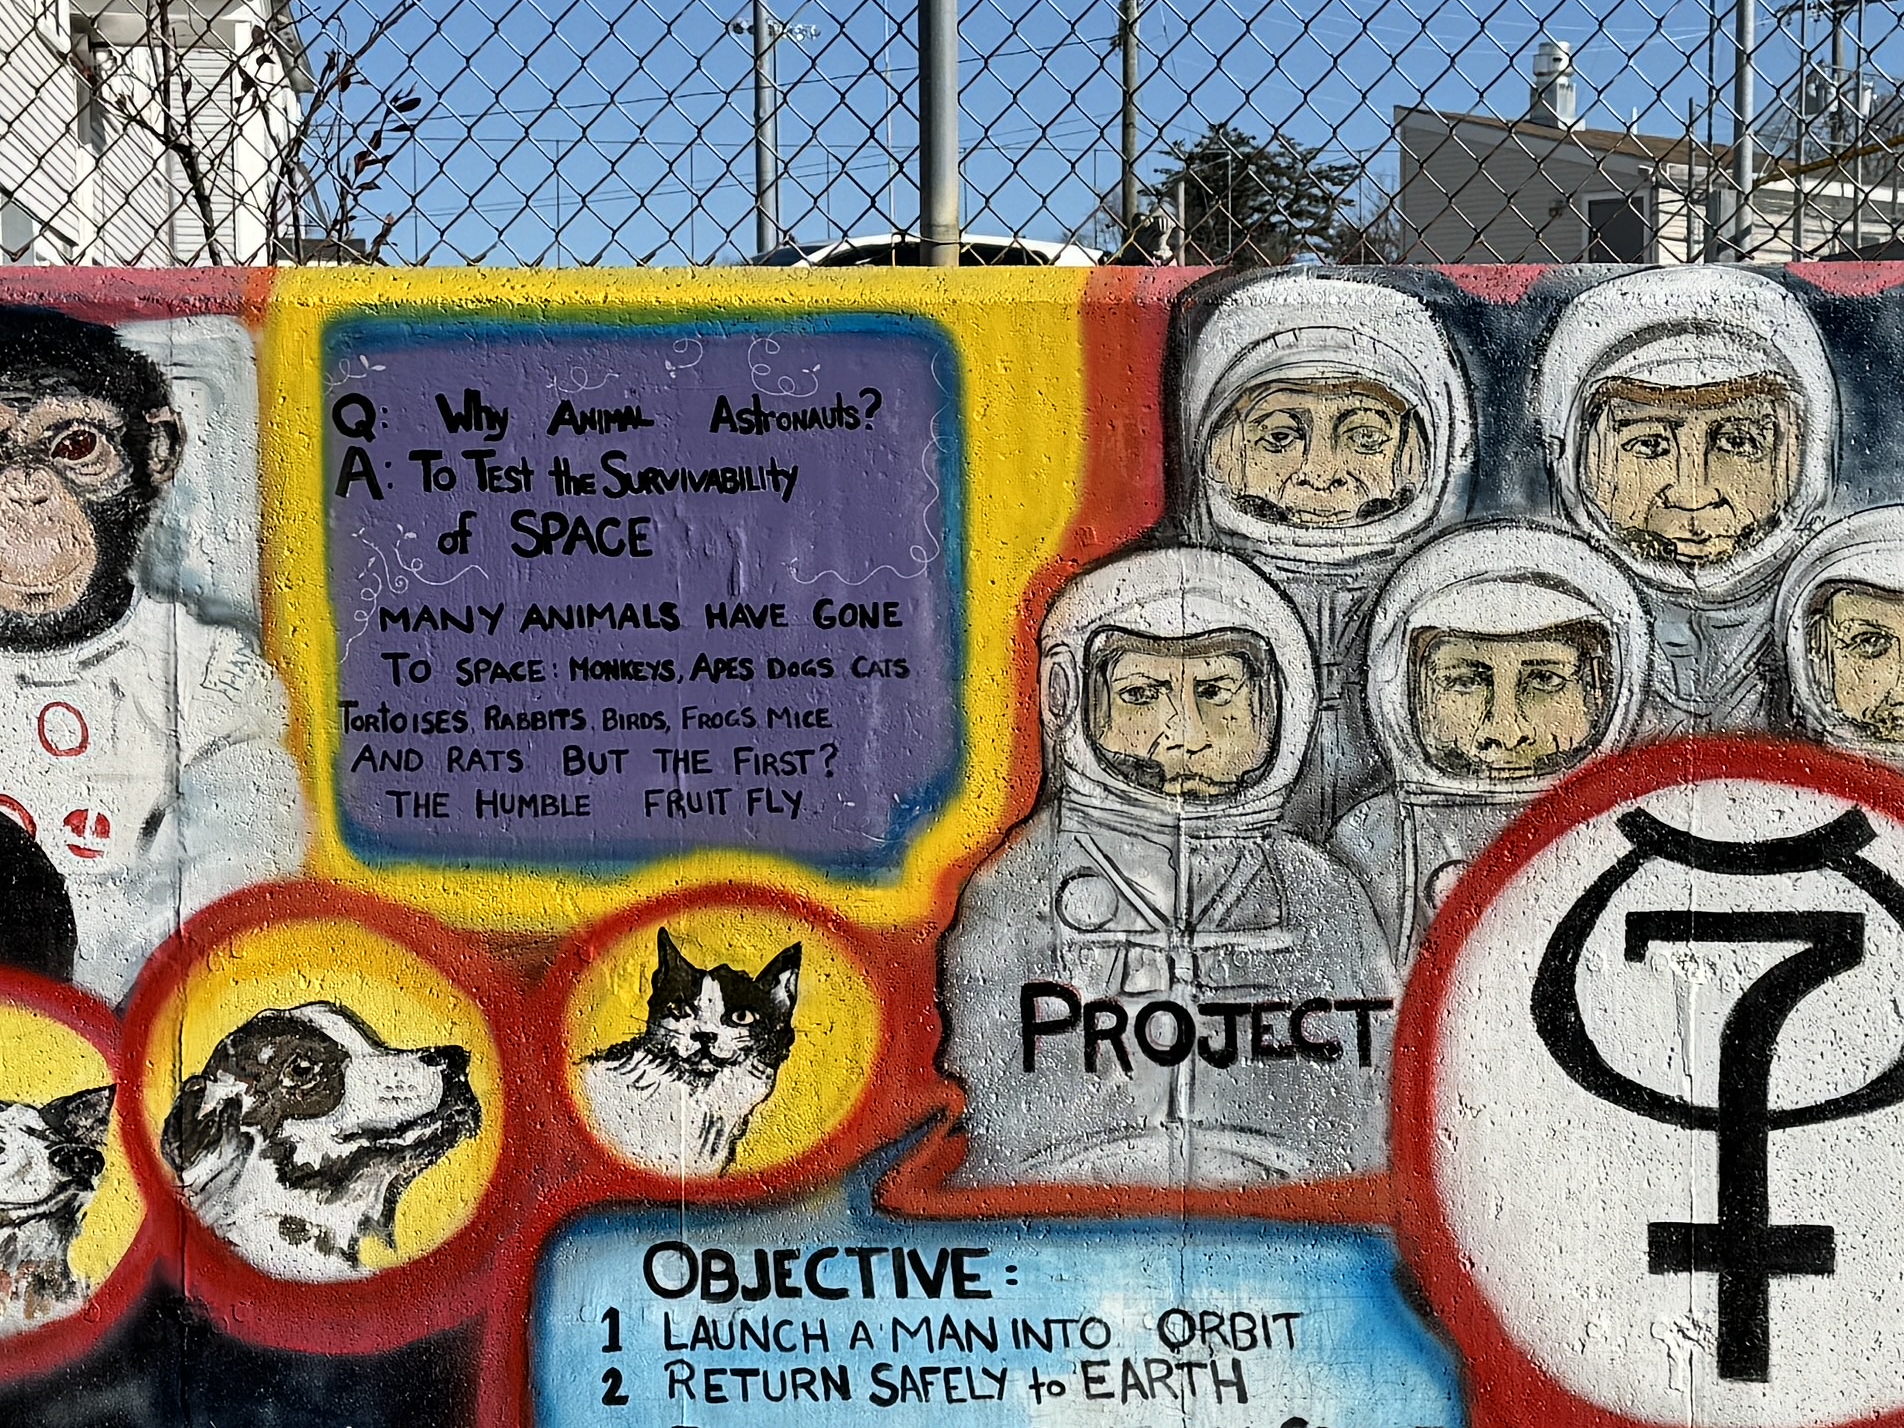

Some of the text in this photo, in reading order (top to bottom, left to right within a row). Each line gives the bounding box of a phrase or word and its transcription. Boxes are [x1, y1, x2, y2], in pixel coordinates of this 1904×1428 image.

[332, 393, 388, 442] Q:
[435, 388, 508, 442] Why
[335, 446, 393, 500] A:
[437, 509, 653, 558] of SPACE
[379, 598, 903, 635] MANY ANIMALS HAVE GONE
[381, 652, 910, 687] TO MONKEYS, APES DOGS CATS
[602, 706, 832, 733] BIRDS, FROGS MICE
[351, 742, 838, 778] AND RATS BUT THE FIRST?
[385, 787, 803, 819] THE HUMBLE FRUIT FLY
[1020, 981, 1394, 1074] PROJECT
[643, 1241, 1019, 1303] OBJECTIVE:
[601, 1306, 1305, 1354] 1 LAUNCH A MAN INTO ORBIT
[601, 1357, 1248, 1408] 2 RETURN SAFELY to EARTH
